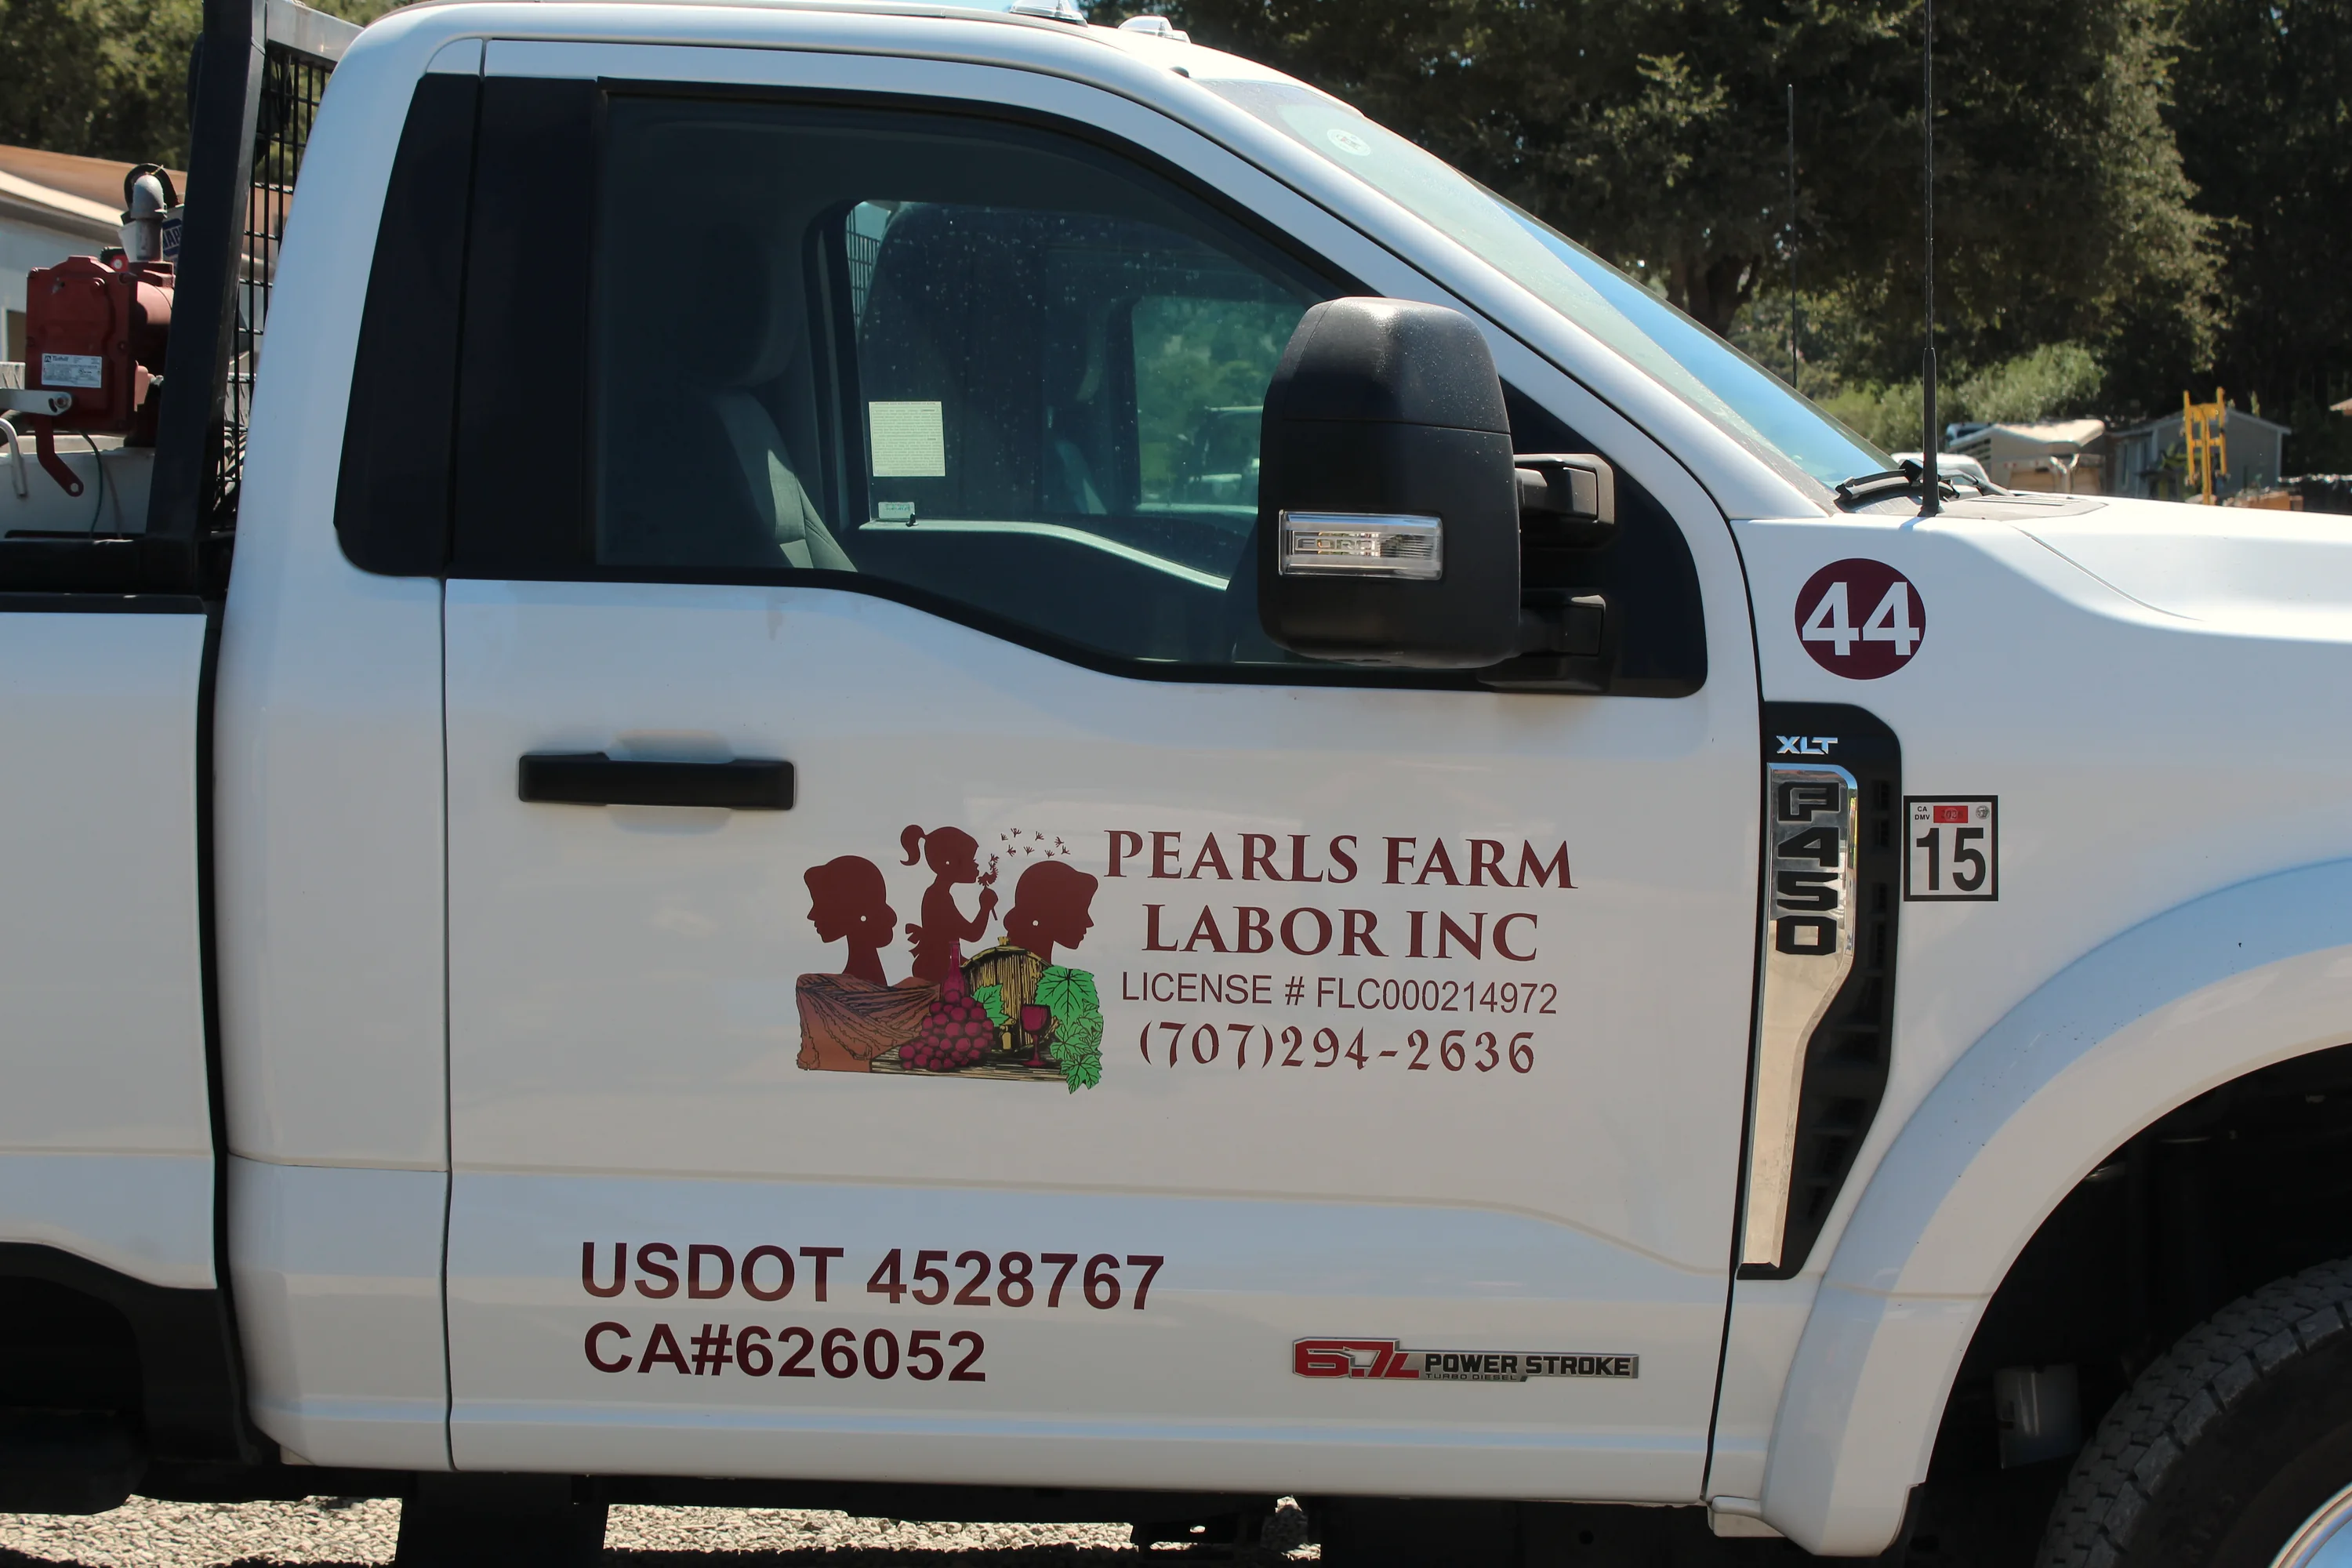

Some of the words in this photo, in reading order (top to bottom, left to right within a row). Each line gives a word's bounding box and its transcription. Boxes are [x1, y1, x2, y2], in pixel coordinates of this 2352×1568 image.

[1296, 538, 1374, 550] FORD
[1802, 581, 1920, 656] 44
[1776, 735, 1838, 755] XLT
[1103, 829, 1358, 884] PEARLS
[1381, 837, 1579, 889] FARM
[1776, 782, 1841, 956] F450
[1916, 827, 1987, 892] 15
[1141, 904, 1389, 957] LABOR
[1405, 910, 1538, 962] INC
[1123, 971, 1272, 1005] LICENSE
[1284, 975, 1305, 1007] #
[1317, 977, 1557, 1014] FLC000214972
[1139, 1020, 1534, 1074] (707)294-2636
[581, 1241, 844, 1302] USDOT
[866, 1248, 1164, 1310] 4528767
[583, 1321, 986, 1382] CA#626052
[1294, 1338, 1420, 1378] 6.7L
[1425, 1353, 1518, 1374] POWER
[1526, 1356, 1631, 1377] STROKE
